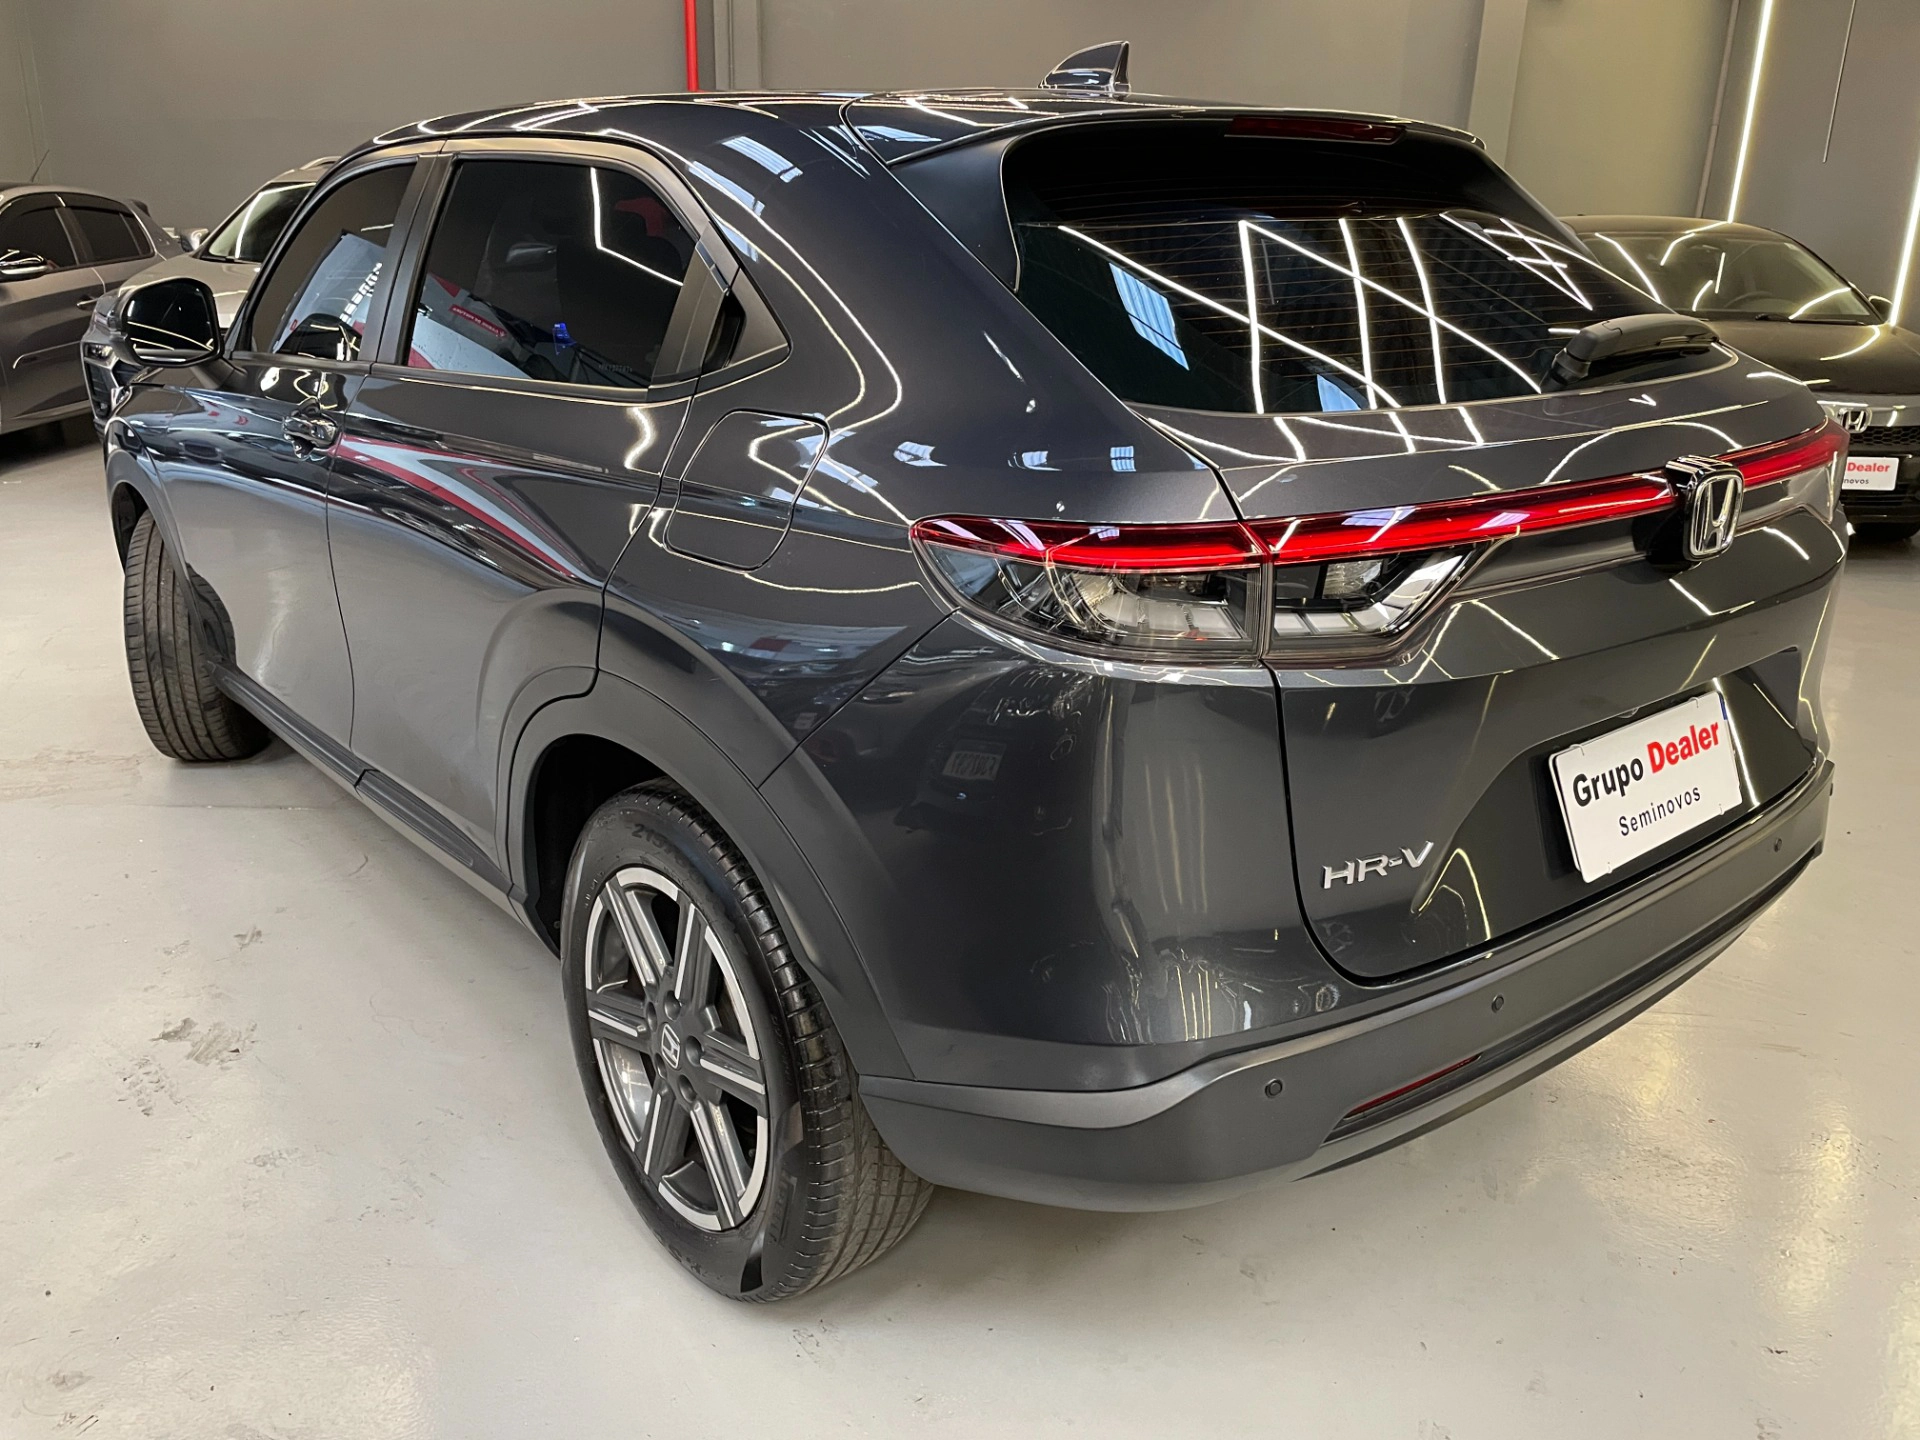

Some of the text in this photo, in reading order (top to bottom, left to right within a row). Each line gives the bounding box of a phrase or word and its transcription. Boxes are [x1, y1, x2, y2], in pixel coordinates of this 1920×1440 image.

[1846, 462, 1890, 473] Dealer
[1572, 722, 1719, 807] Grupo Dealer
[1619, 787, 1701, 836] Seminovos
[1322, 841, 1434, 889] HR-V
